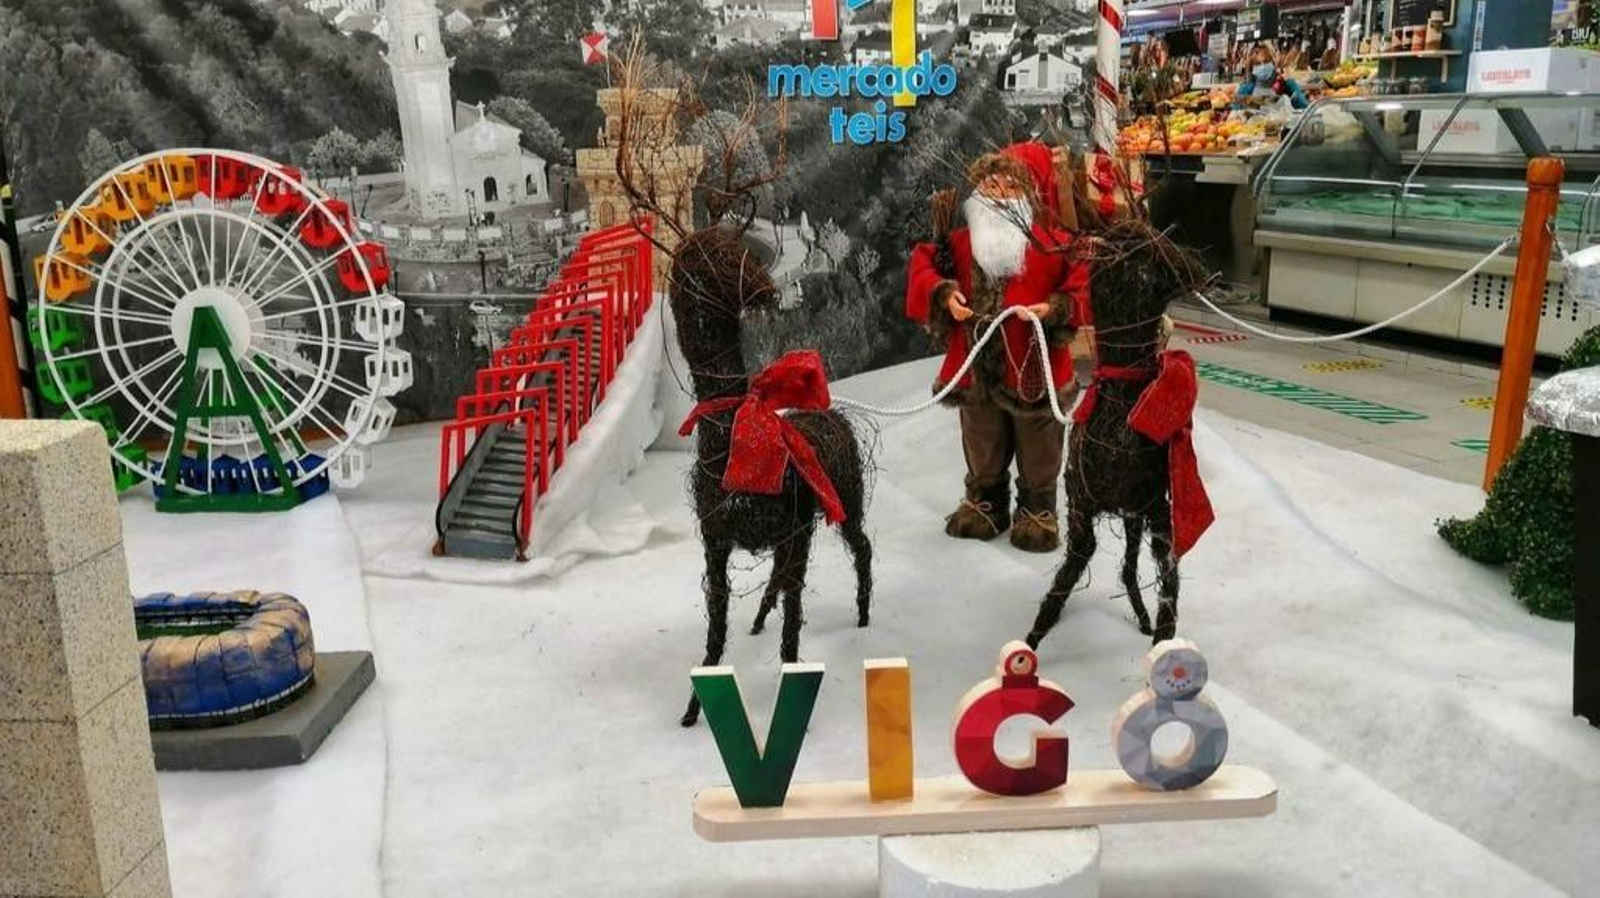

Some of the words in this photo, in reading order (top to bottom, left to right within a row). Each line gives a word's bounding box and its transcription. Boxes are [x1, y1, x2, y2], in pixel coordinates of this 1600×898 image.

[767, 49, 957, 98] mercado
[829, 99, 907, 145] teis
[690, 640, 1229, 808] VIGO
